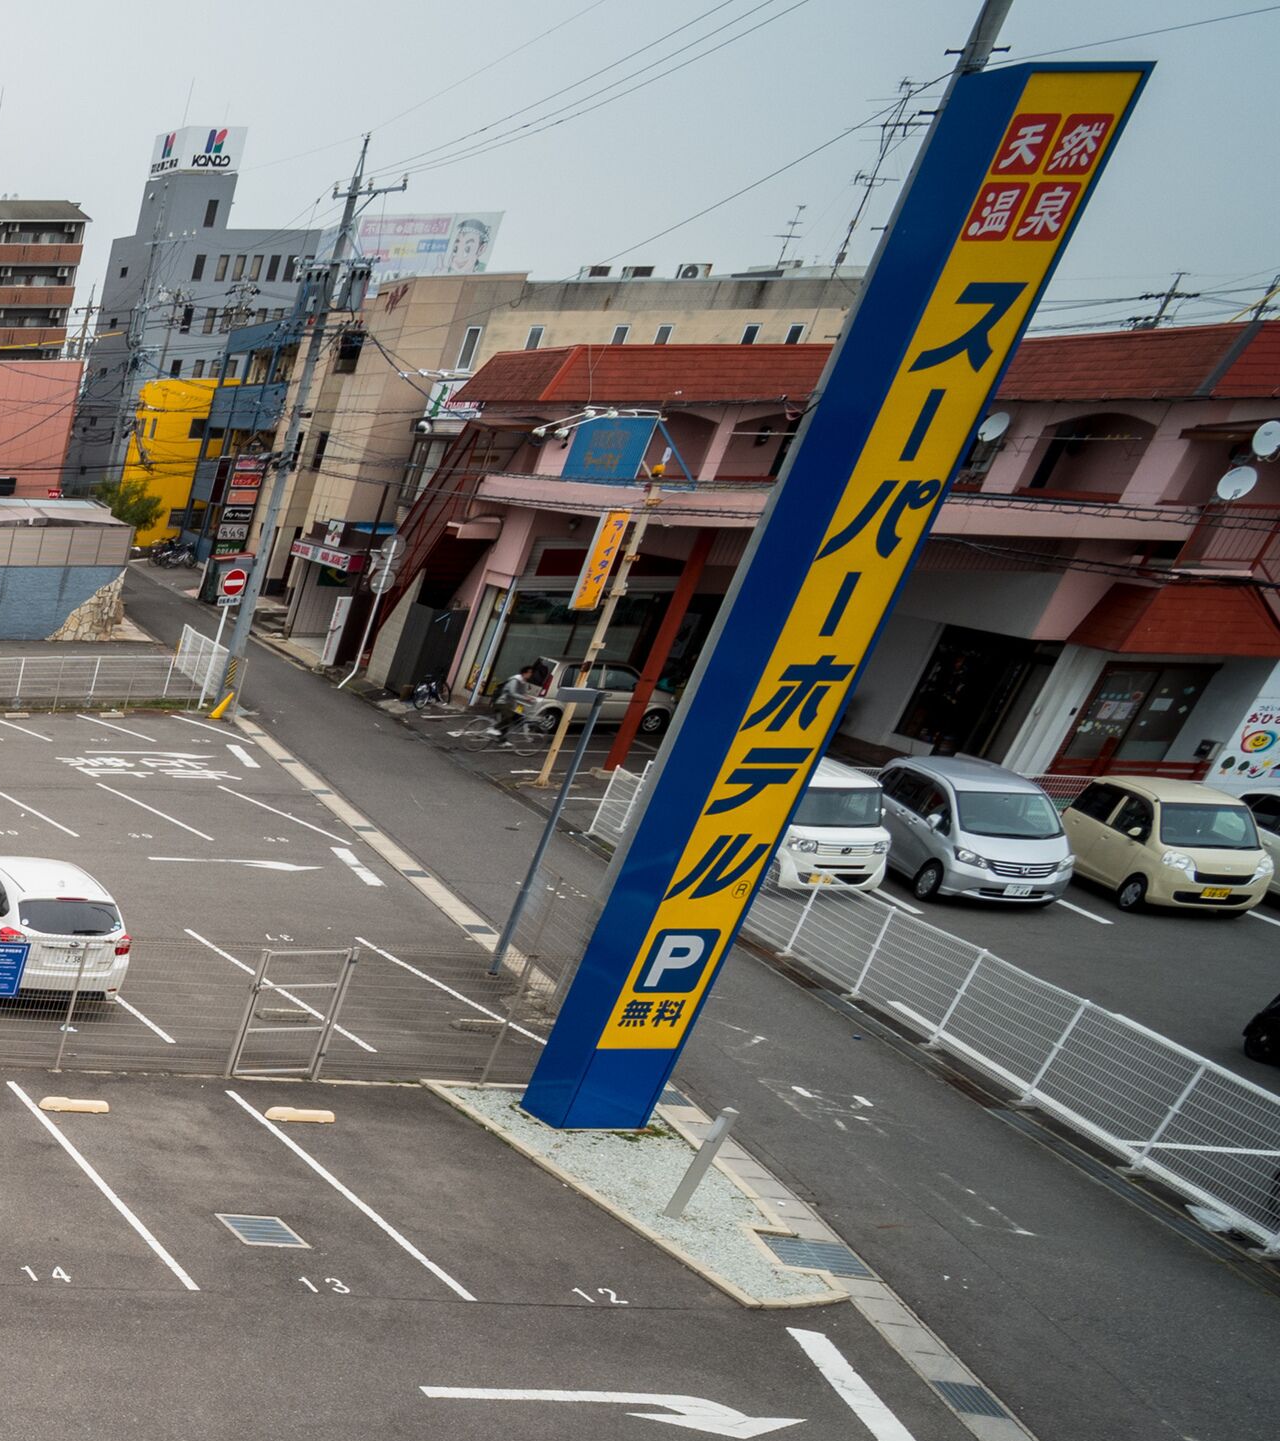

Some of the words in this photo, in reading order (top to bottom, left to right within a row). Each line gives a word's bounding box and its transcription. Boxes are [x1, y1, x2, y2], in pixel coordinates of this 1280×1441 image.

[999, 122, 1107, 170] 天然
[967, 186, 1073, 238] 温泉
[662, 281, 1030, 901] スーパーホテル
[645, 935, 706, 988] P
[617, 1000, 682, 1028] 無料
[22, 1265, 73, 1282] 14
[298, 1275, 351, 1295] 13
[570, 1286, 630, 1306] 12
